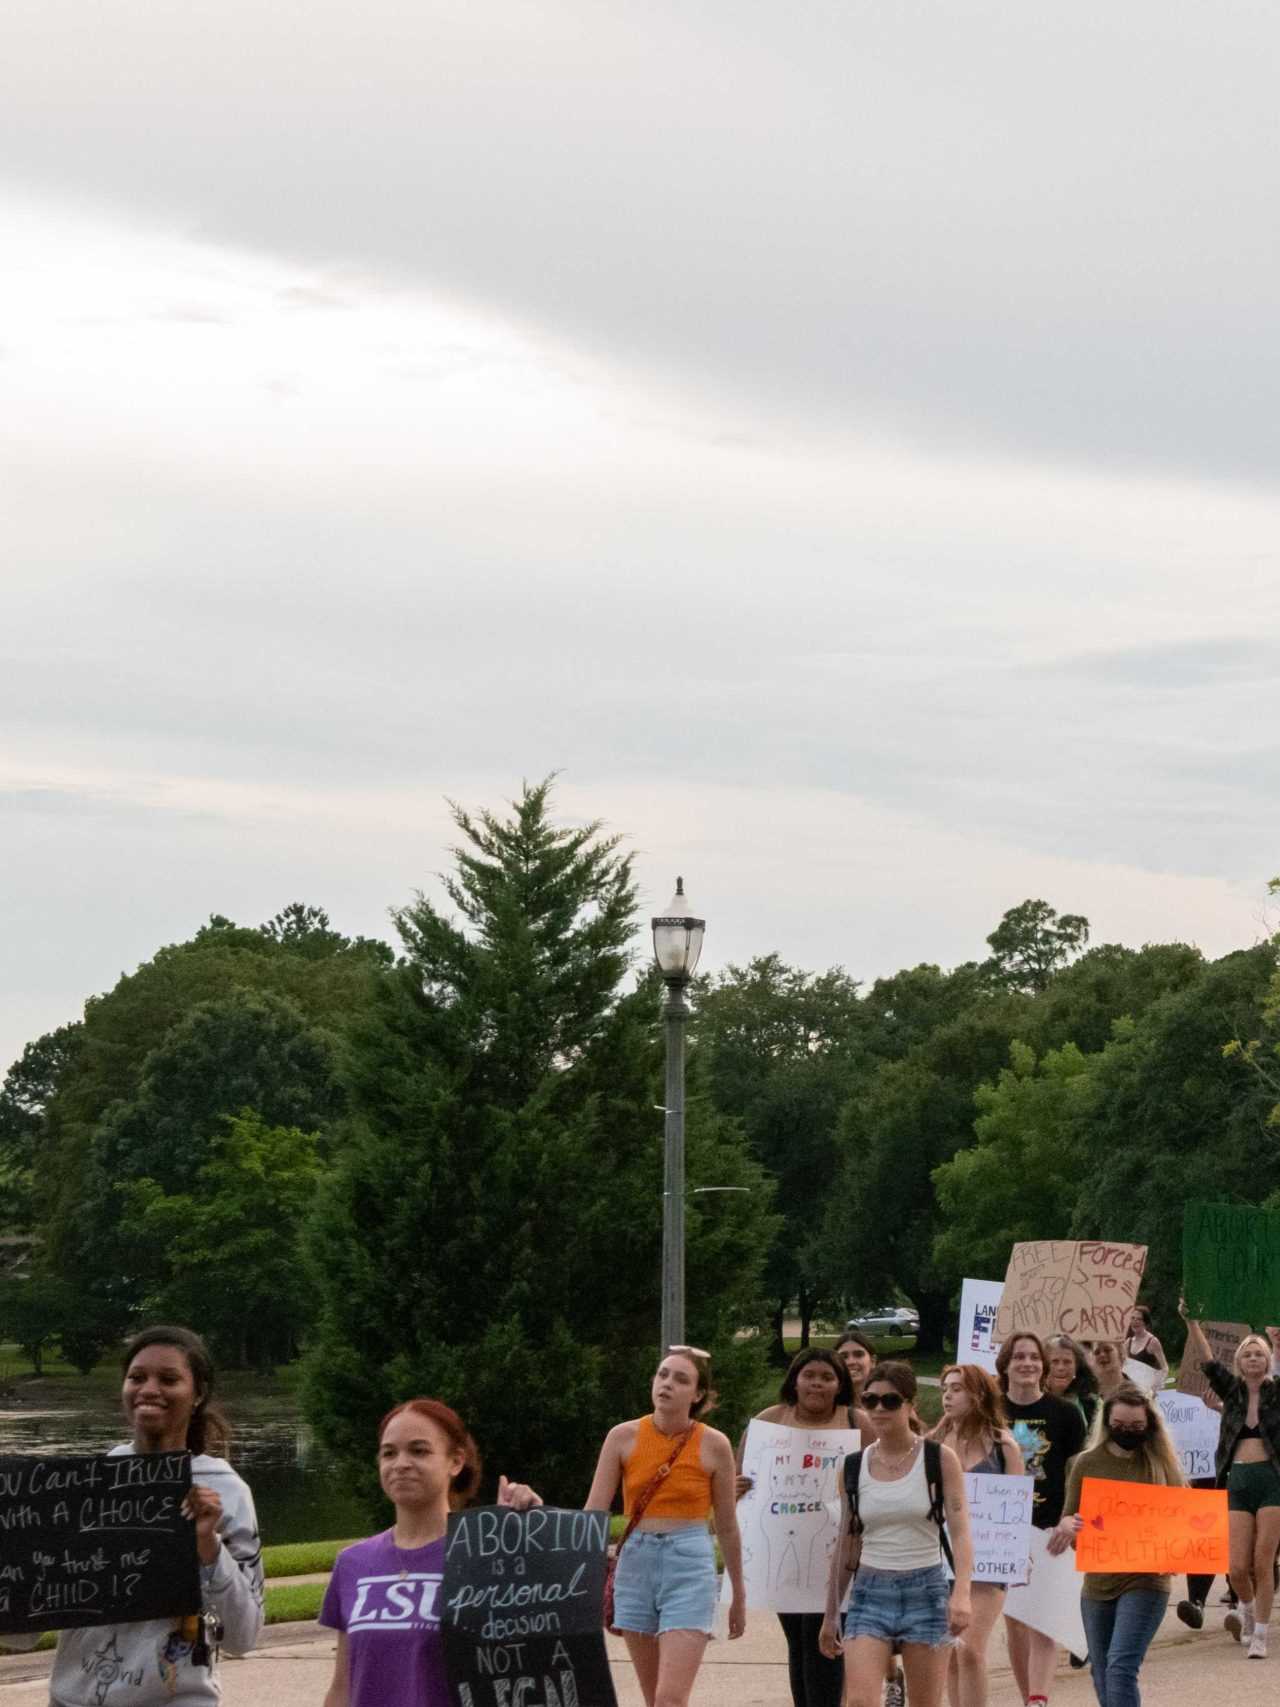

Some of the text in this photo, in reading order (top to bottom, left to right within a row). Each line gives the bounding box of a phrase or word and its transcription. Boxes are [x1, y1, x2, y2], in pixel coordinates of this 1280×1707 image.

[1011, 1241, 1071, 1272] FREE
[1079, 1242, 1146, 1278] Forced
[1092, 1274, 1118, 1290] TO
[975, 1303, 997, 1317] LAN
[1059, 1304, 1133, 1335] CARRY
[0, 1455, 187, 1496] OU Can't TRUST
[801, 1453, 839, 1470] BODY
[52, 1500, 70, 1526] A
[79, 1496, 175, 1530] CHOICE
[770, 1501, 823, 1516] CHOICE
[0, 1565, 25, 1583] an
[60, 1547, 111, 1575] trust
[120, 1548, 151, 1568] me
[491, 1555, 526, 1576] is a
[1081, 1536, 1222, 1565] HEALTHCARE
[973, 1558, 1026, 1575] OTHER?
[447, 1562, 589, 1627] personal
[480, 1610, 562, 1640] decision
[475, 1639, 575, 1675] NOT A
